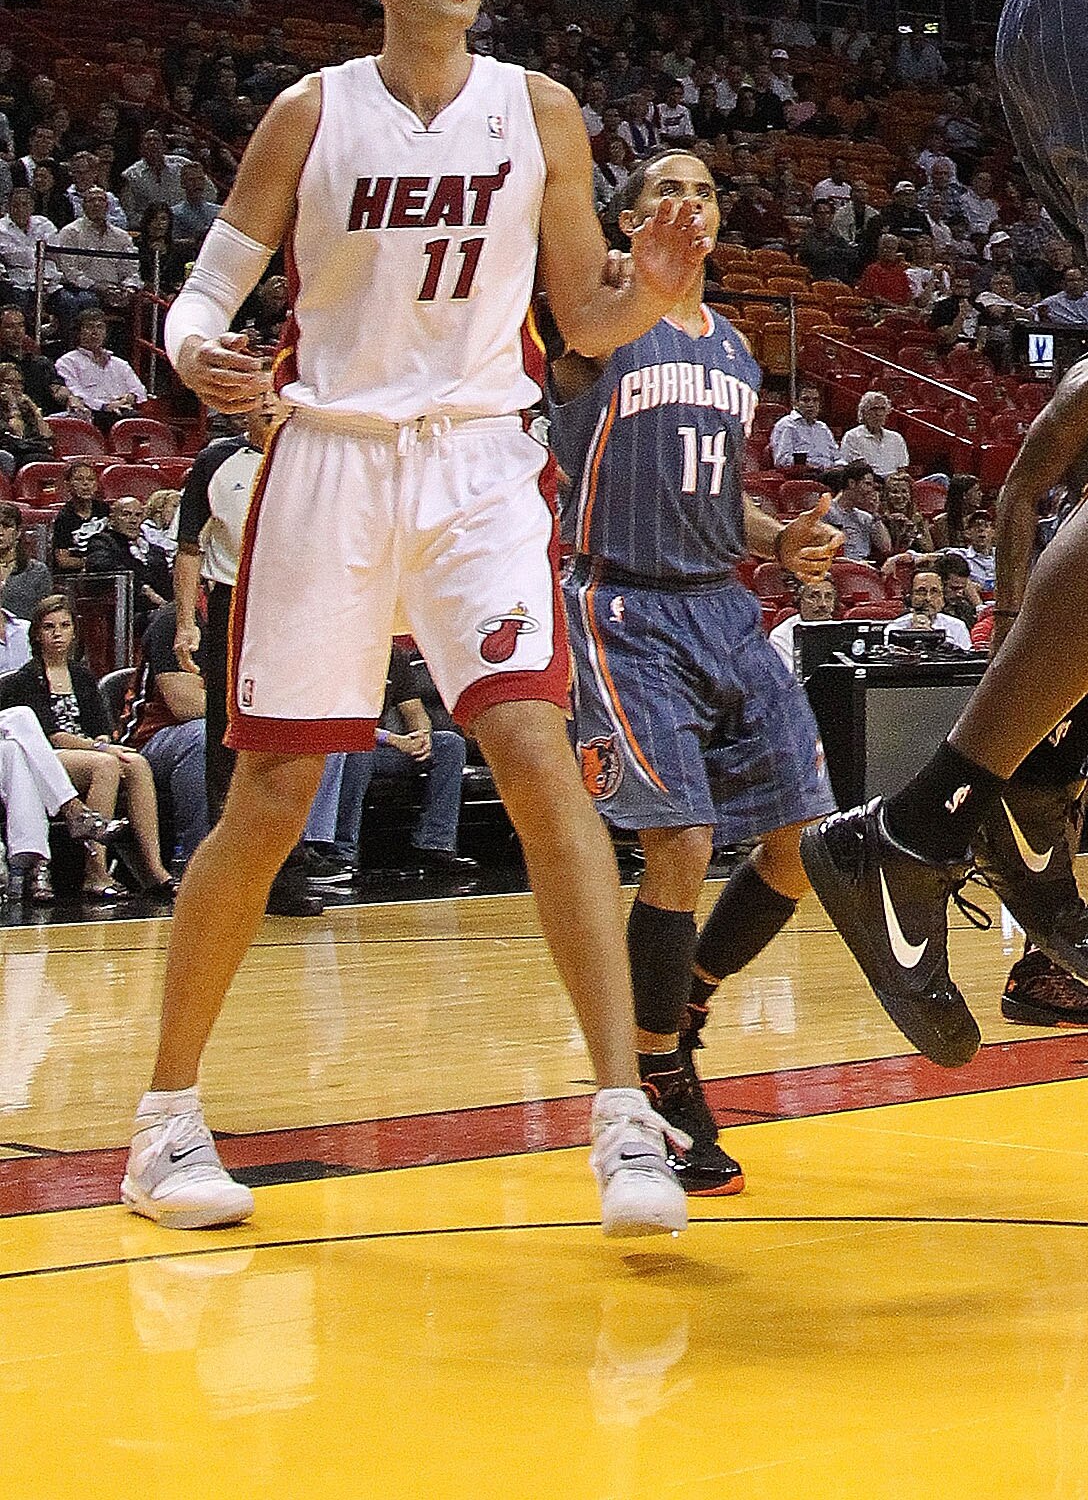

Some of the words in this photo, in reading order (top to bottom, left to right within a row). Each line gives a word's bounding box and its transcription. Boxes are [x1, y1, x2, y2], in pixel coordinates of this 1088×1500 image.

[347, 156, 512, 233] HEAT
[416, 236, 487, 303] 11
[677, 425, 728, 495] 14
